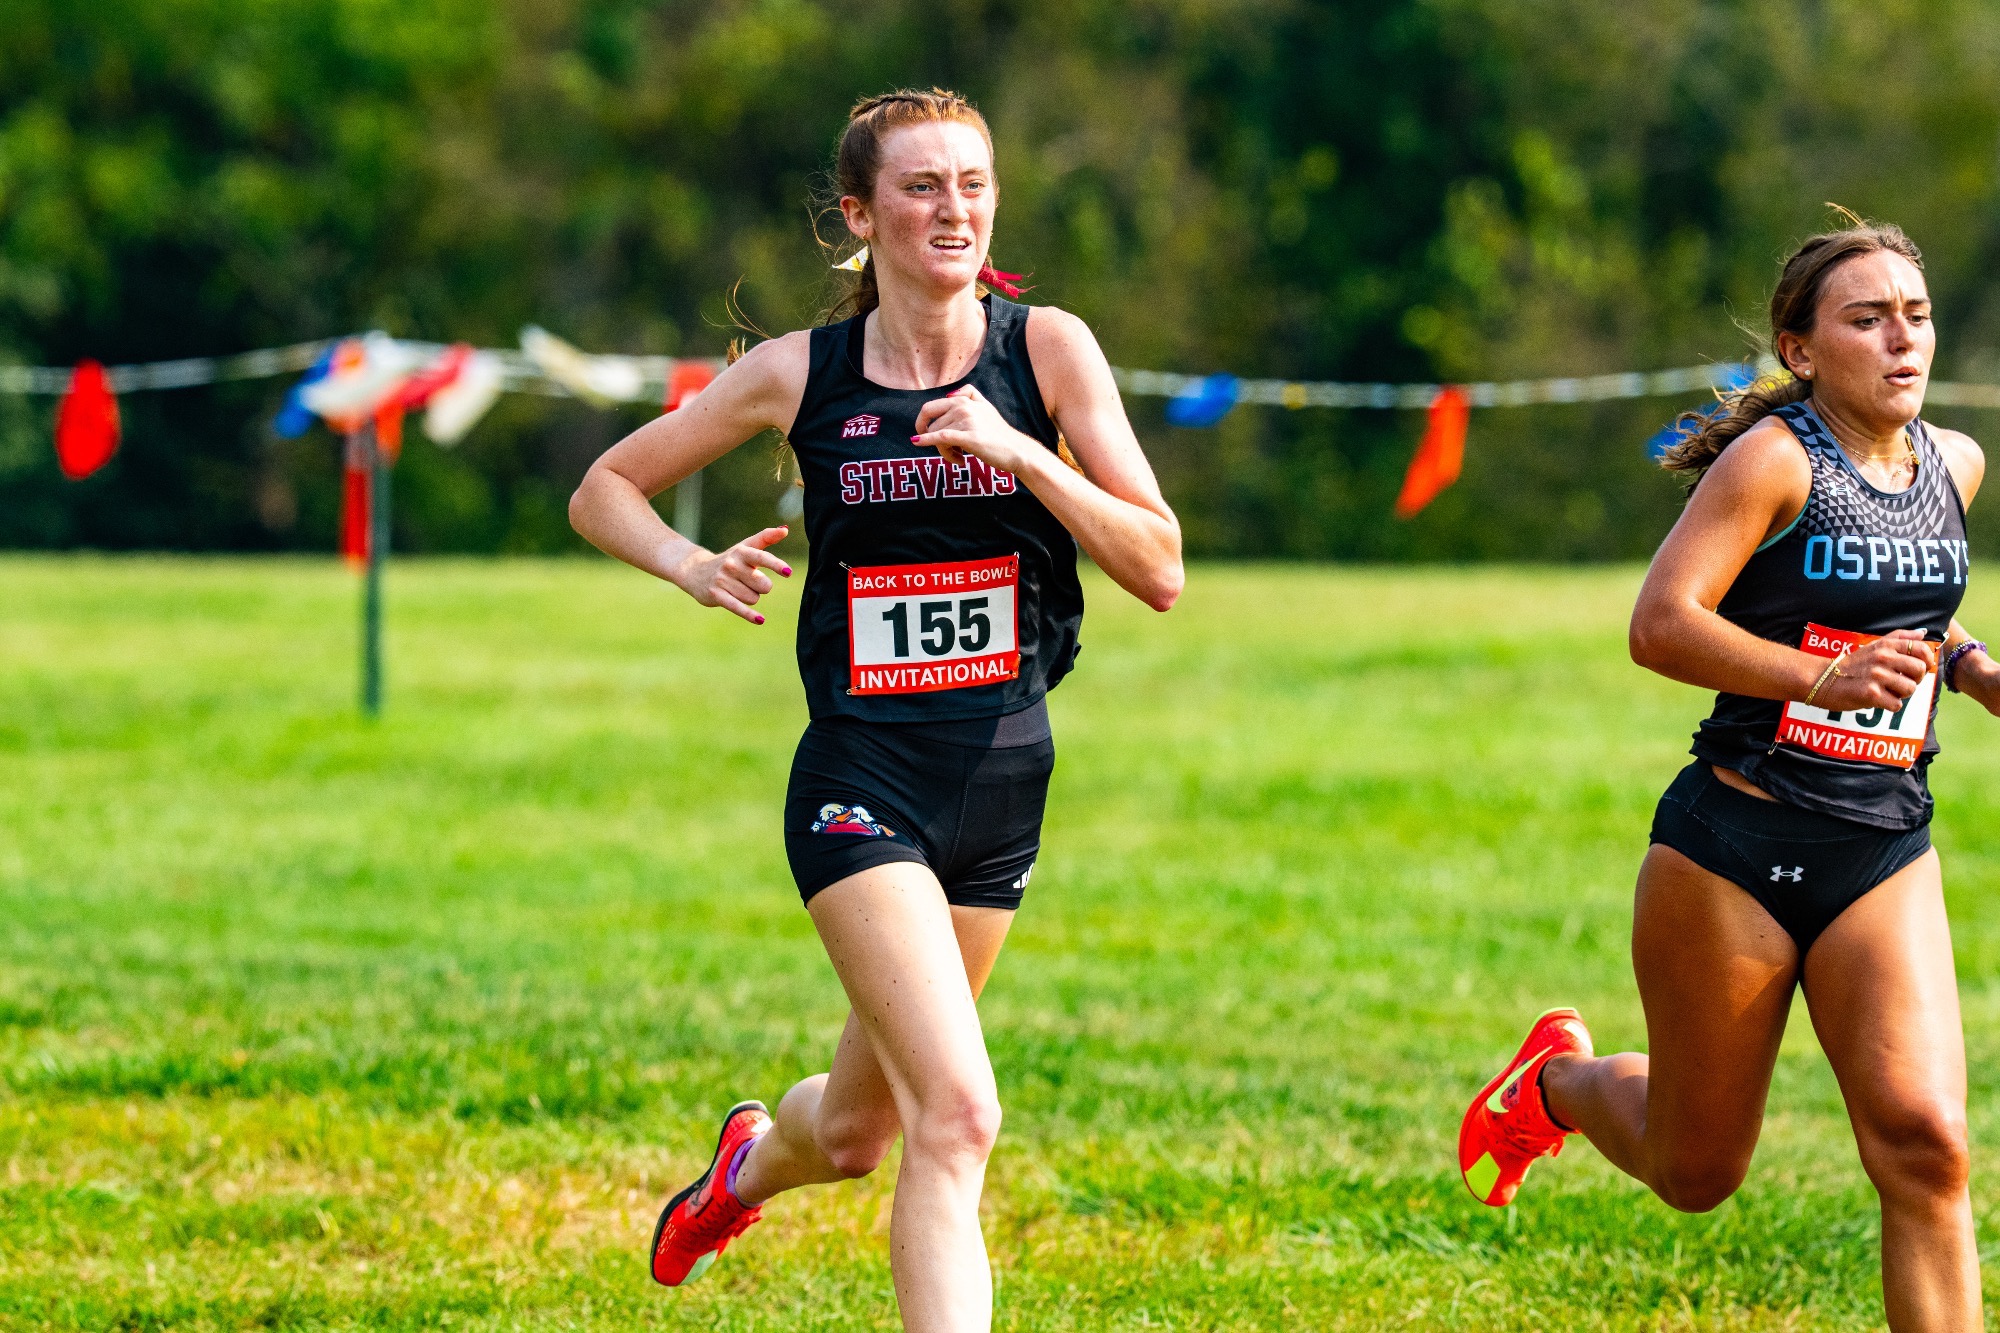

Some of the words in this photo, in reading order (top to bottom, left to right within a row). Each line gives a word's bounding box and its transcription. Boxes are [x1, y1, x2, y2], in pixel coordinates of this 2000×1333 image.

[842, 424, 878, 438] MAC
[839, 454, 1016, 504] STEVENS
[853, 575, 898, 590] BACK
[903, 574, 926, 587] TO
[931, 572, 965, 586] THE
[970, 567, 1013, 583] BOWL
[882, 596, 991, 658] 155
[1807, 634, 1853, 654] BACK
[860, 658, 1010, 689] INVITATIONAL
[1786, 723, 1916, 762] INVITATIONAL
